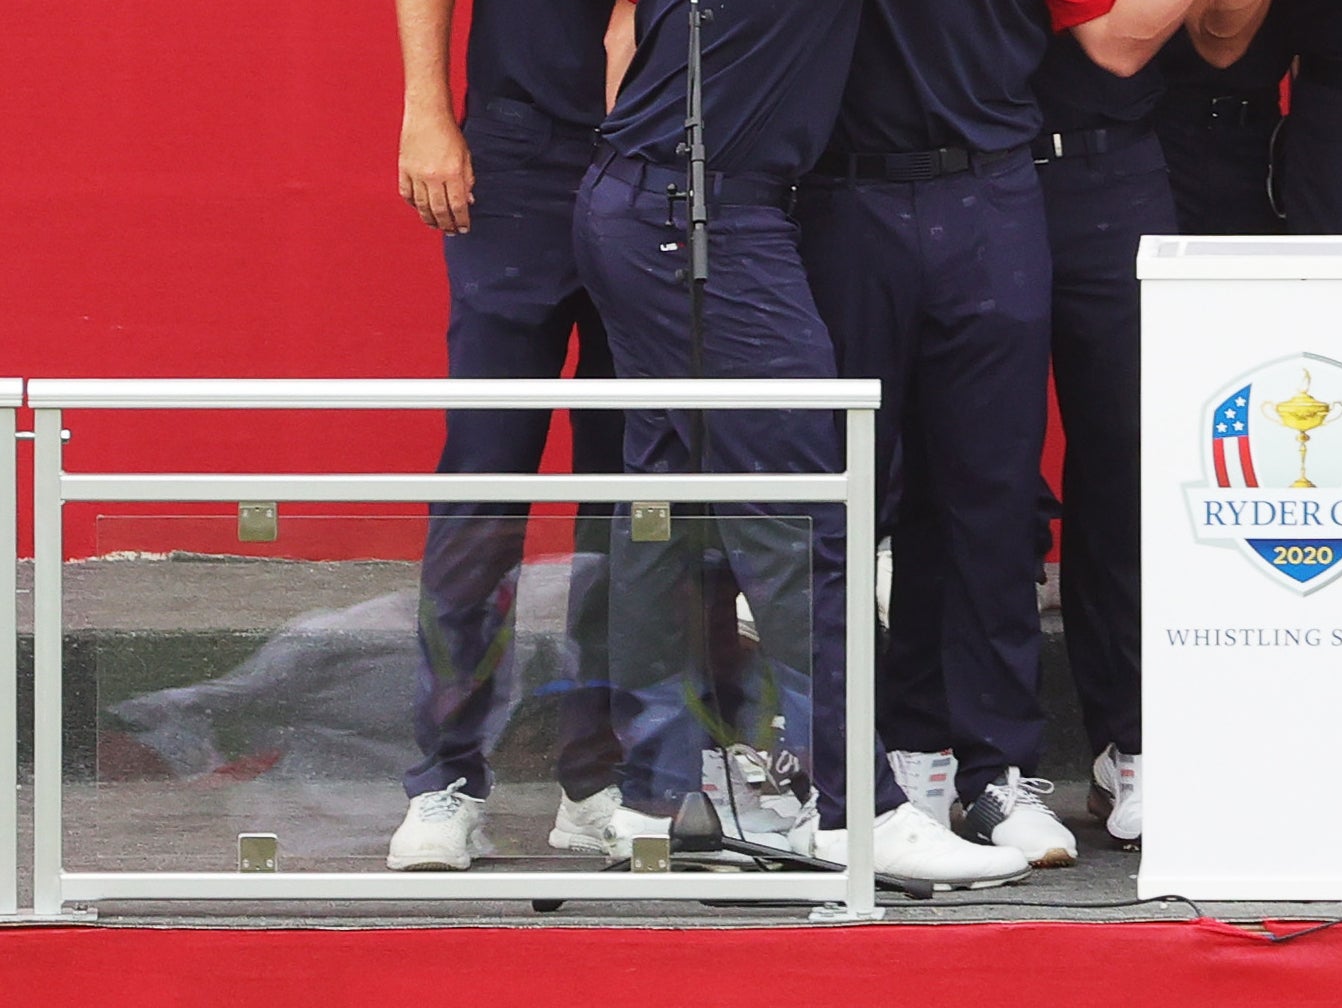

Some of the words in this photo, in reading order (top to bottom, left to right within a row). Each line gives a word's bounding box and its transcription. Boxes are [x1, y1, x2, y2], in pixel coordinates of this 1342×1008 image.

[1203, 500, 1323, 526] RYDER
[1272, 545, 1335, 565] 2020
[1166, 628, 1322, 647] WHISTLING
